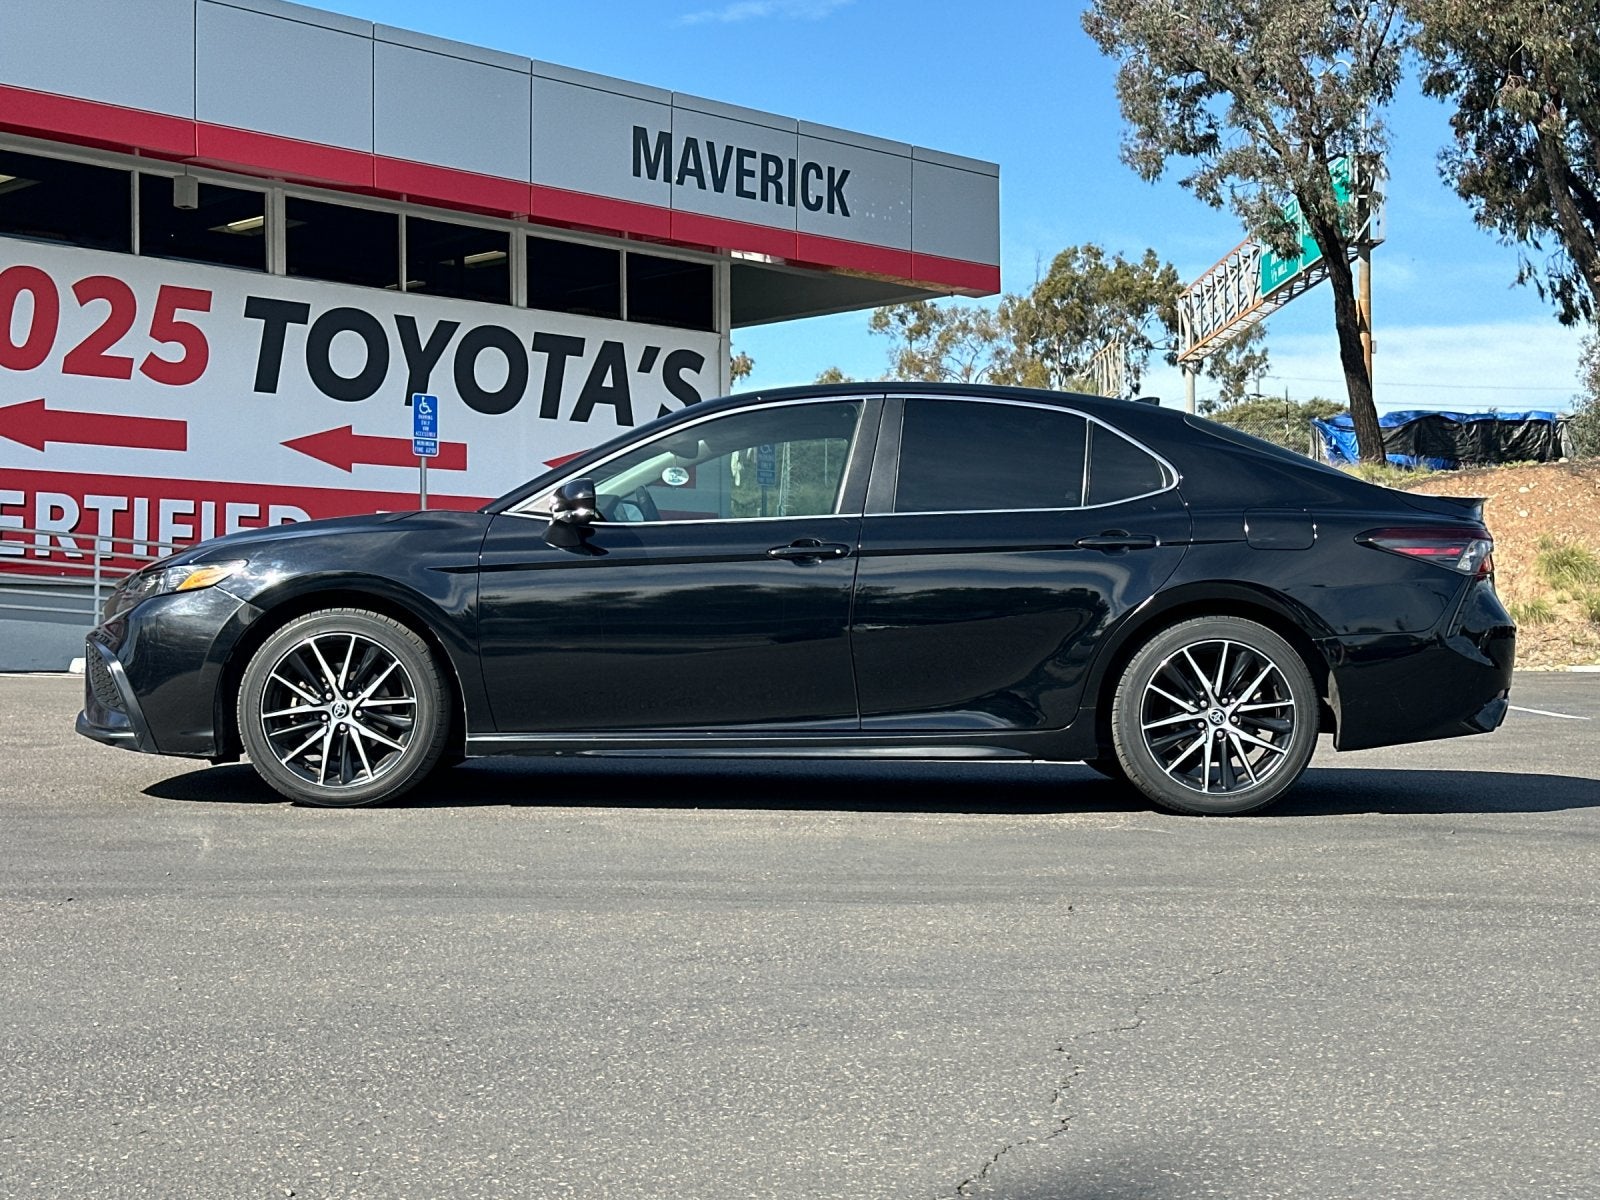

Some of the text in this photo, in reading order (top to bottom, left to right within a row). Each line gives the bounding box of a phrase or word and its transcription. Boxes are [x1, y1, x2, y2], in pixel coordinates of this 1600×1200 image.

[633, 125, 850, 217] MAVERICK
[0, 265, 705, 427] 025 TOYOTA'S
